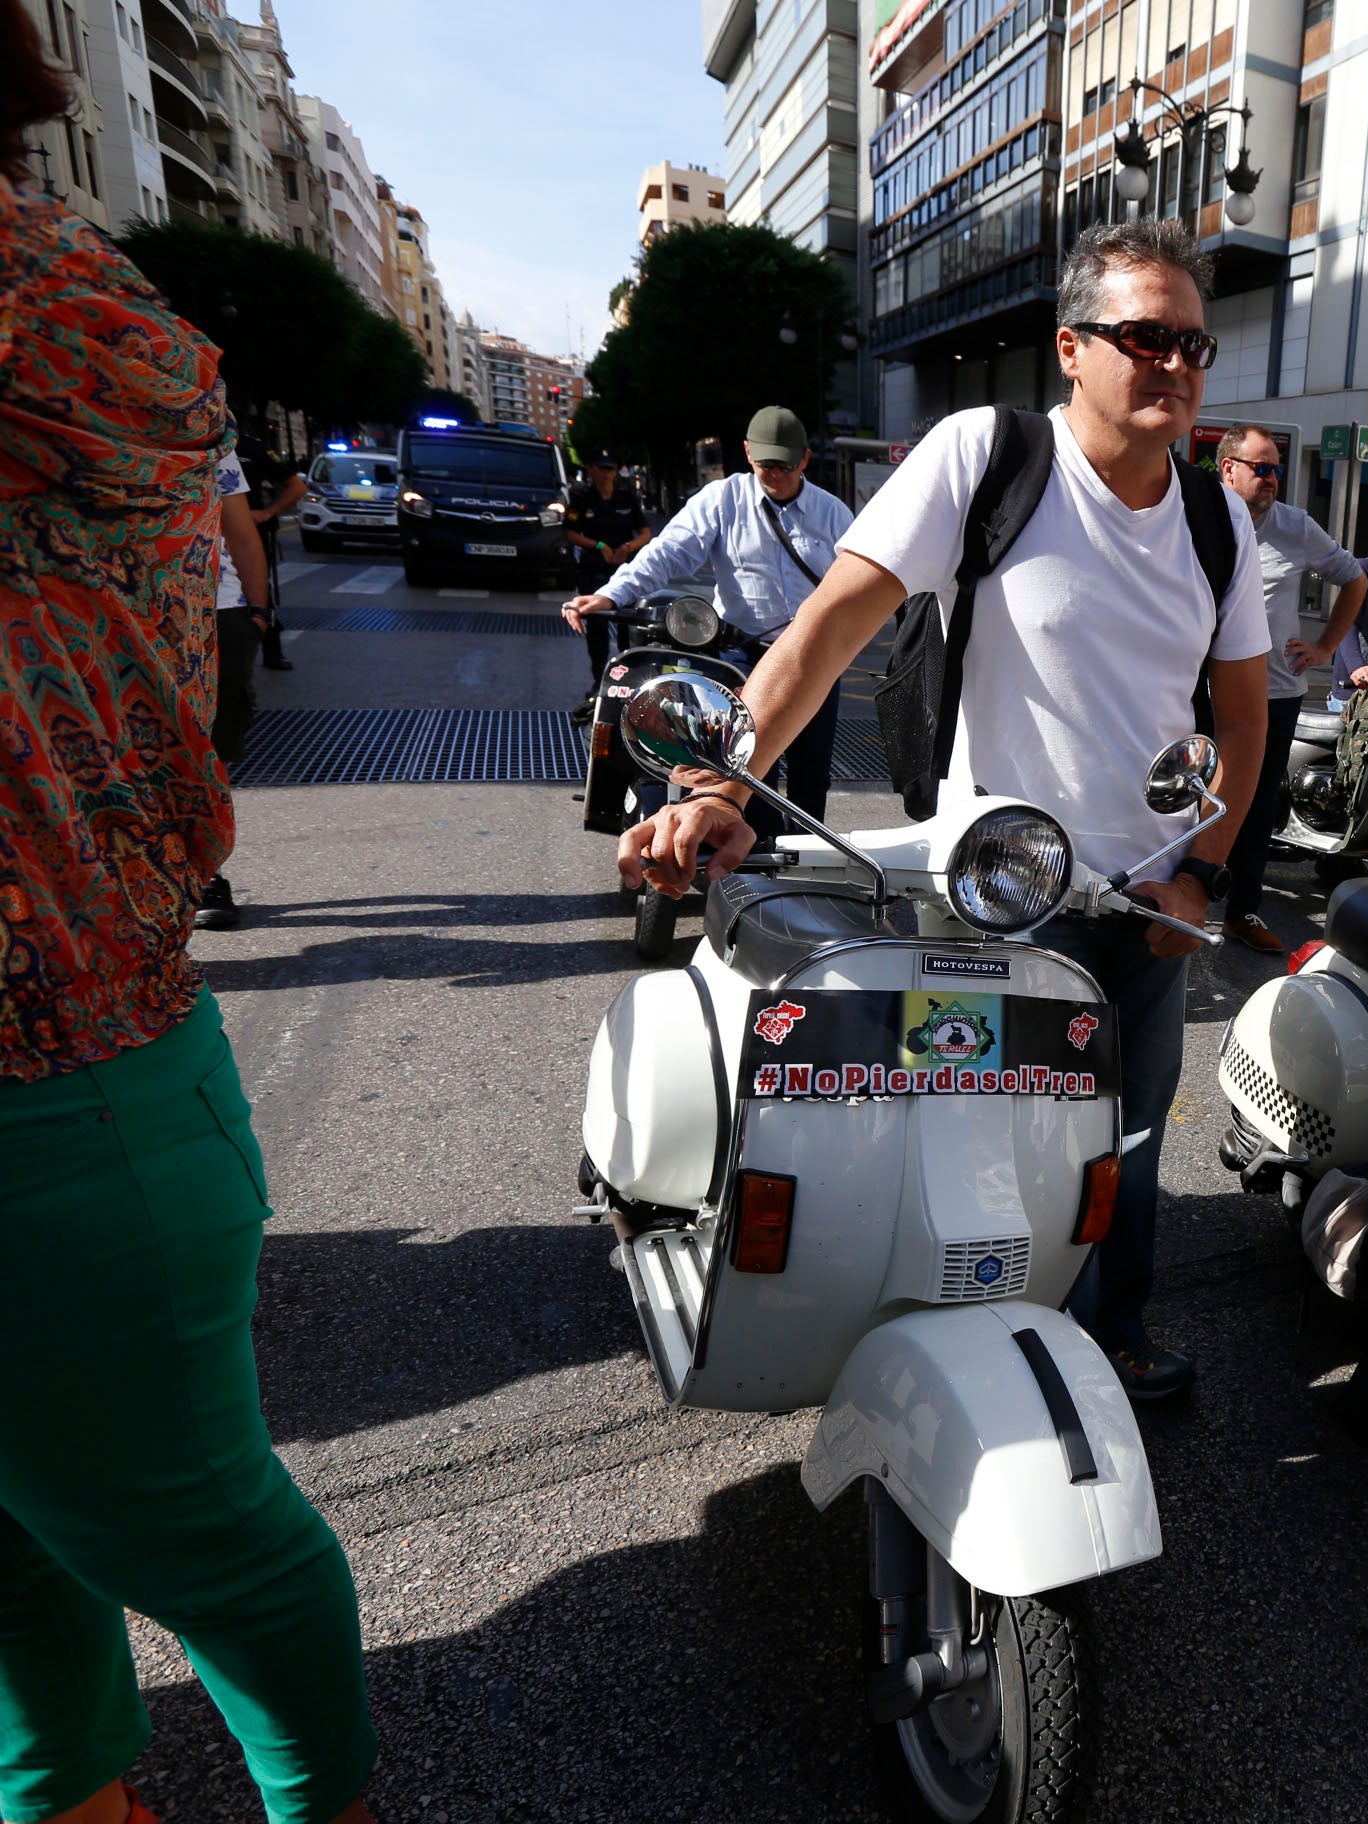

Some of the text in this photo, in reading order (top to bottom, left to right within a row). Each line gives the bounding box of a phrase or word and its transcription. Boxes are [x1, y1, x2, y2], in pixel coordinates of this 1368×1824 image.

[451, 497, 520, 508] POLICIA
[933, 960, 1004, 972] MOTOVESPA
[939, 1044, 972, 1053] TERUEL
[754, 1063, 1096, 1096] #NoPierdaselTren
